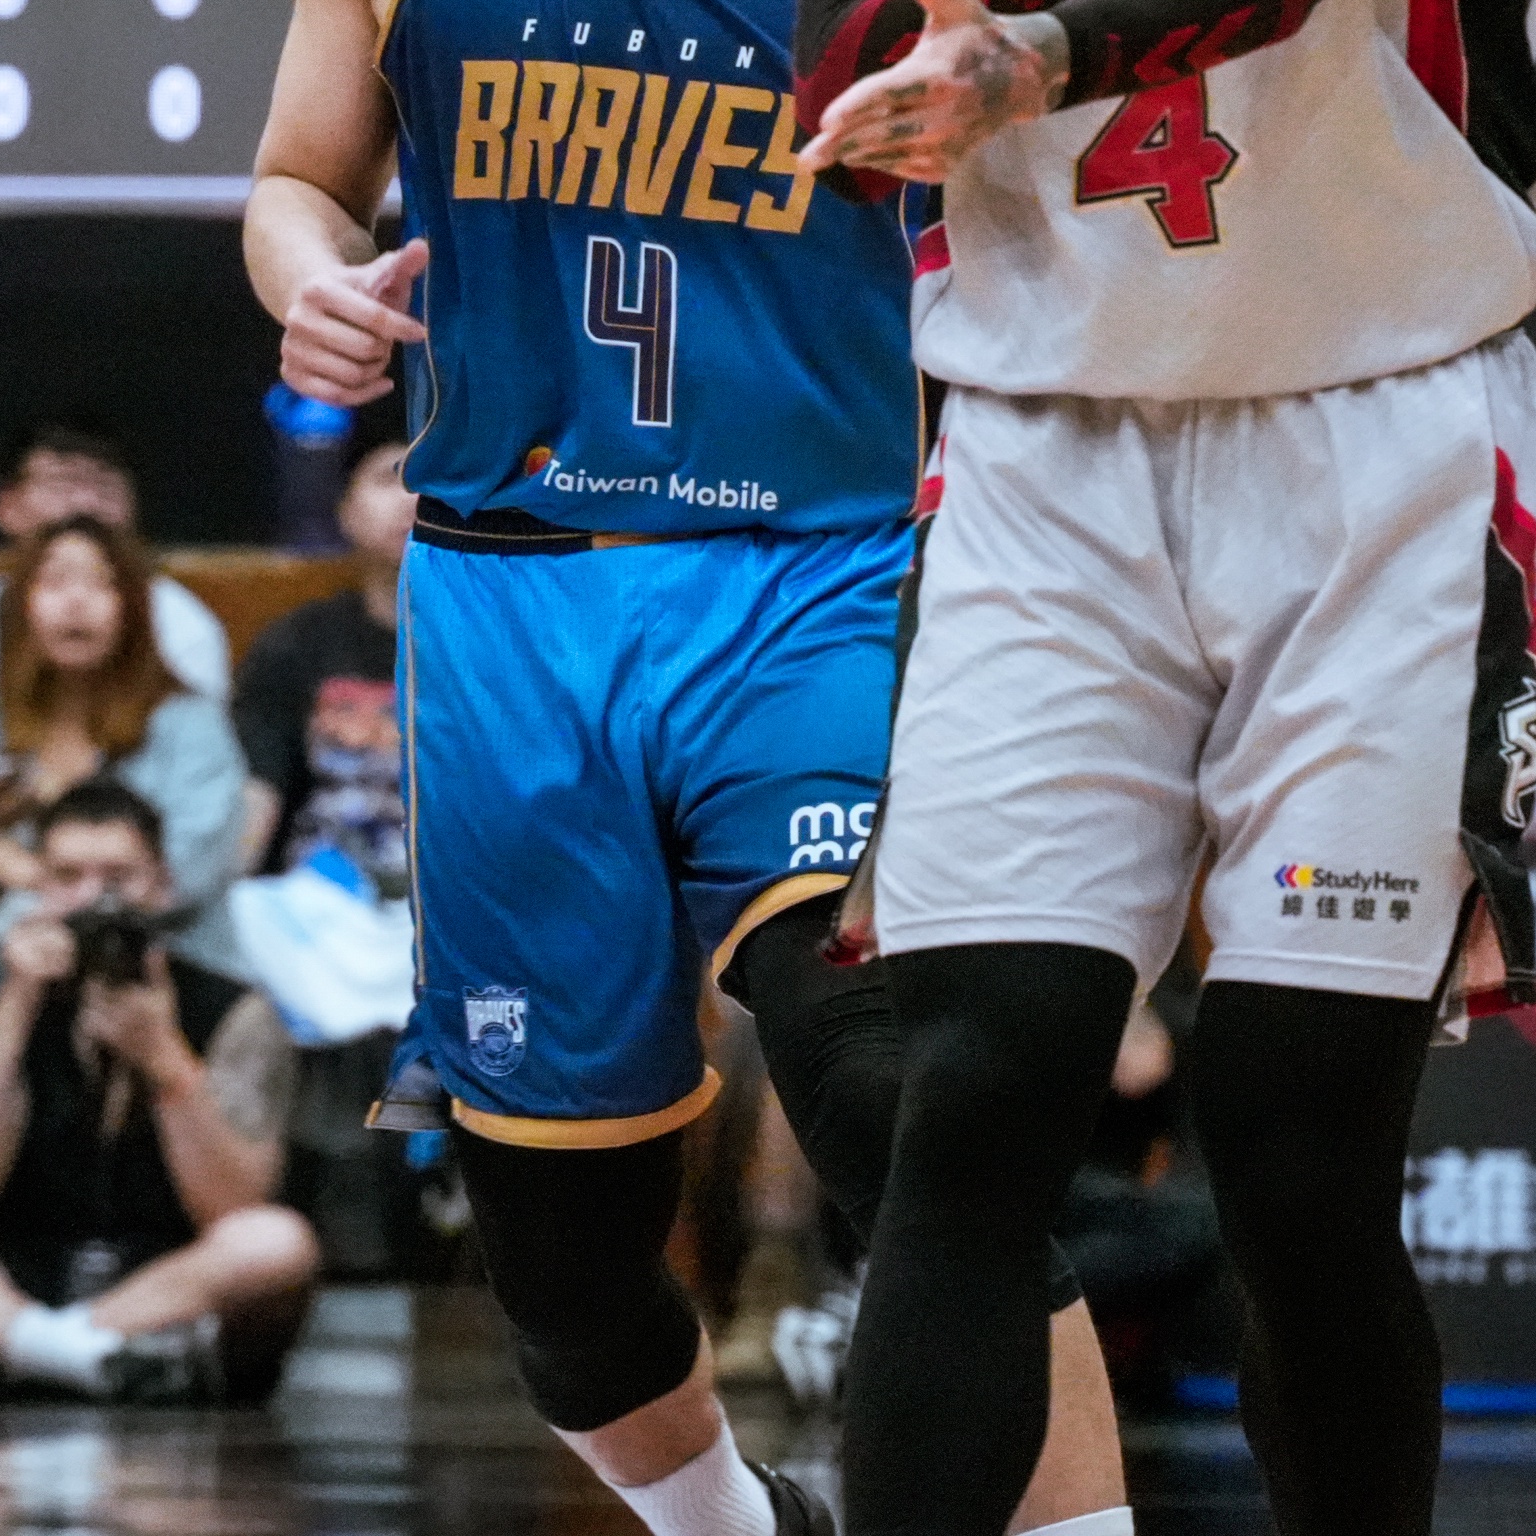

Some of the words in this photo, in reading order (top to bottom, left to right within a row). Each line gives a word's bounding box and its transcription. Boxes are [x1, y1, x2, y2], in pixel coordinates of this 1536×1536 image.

[146, 62, 204, 145] 0
[452, 59, 816, 233] BRAVES
[1075, 72, 1238, 247] 4
[583, 235, 678, 428] 4
[543, 458, 658, 495] Taiwan
[668, 472, 779, 511] Mobile
[1312, 866, 1421, 894] StudyHere
